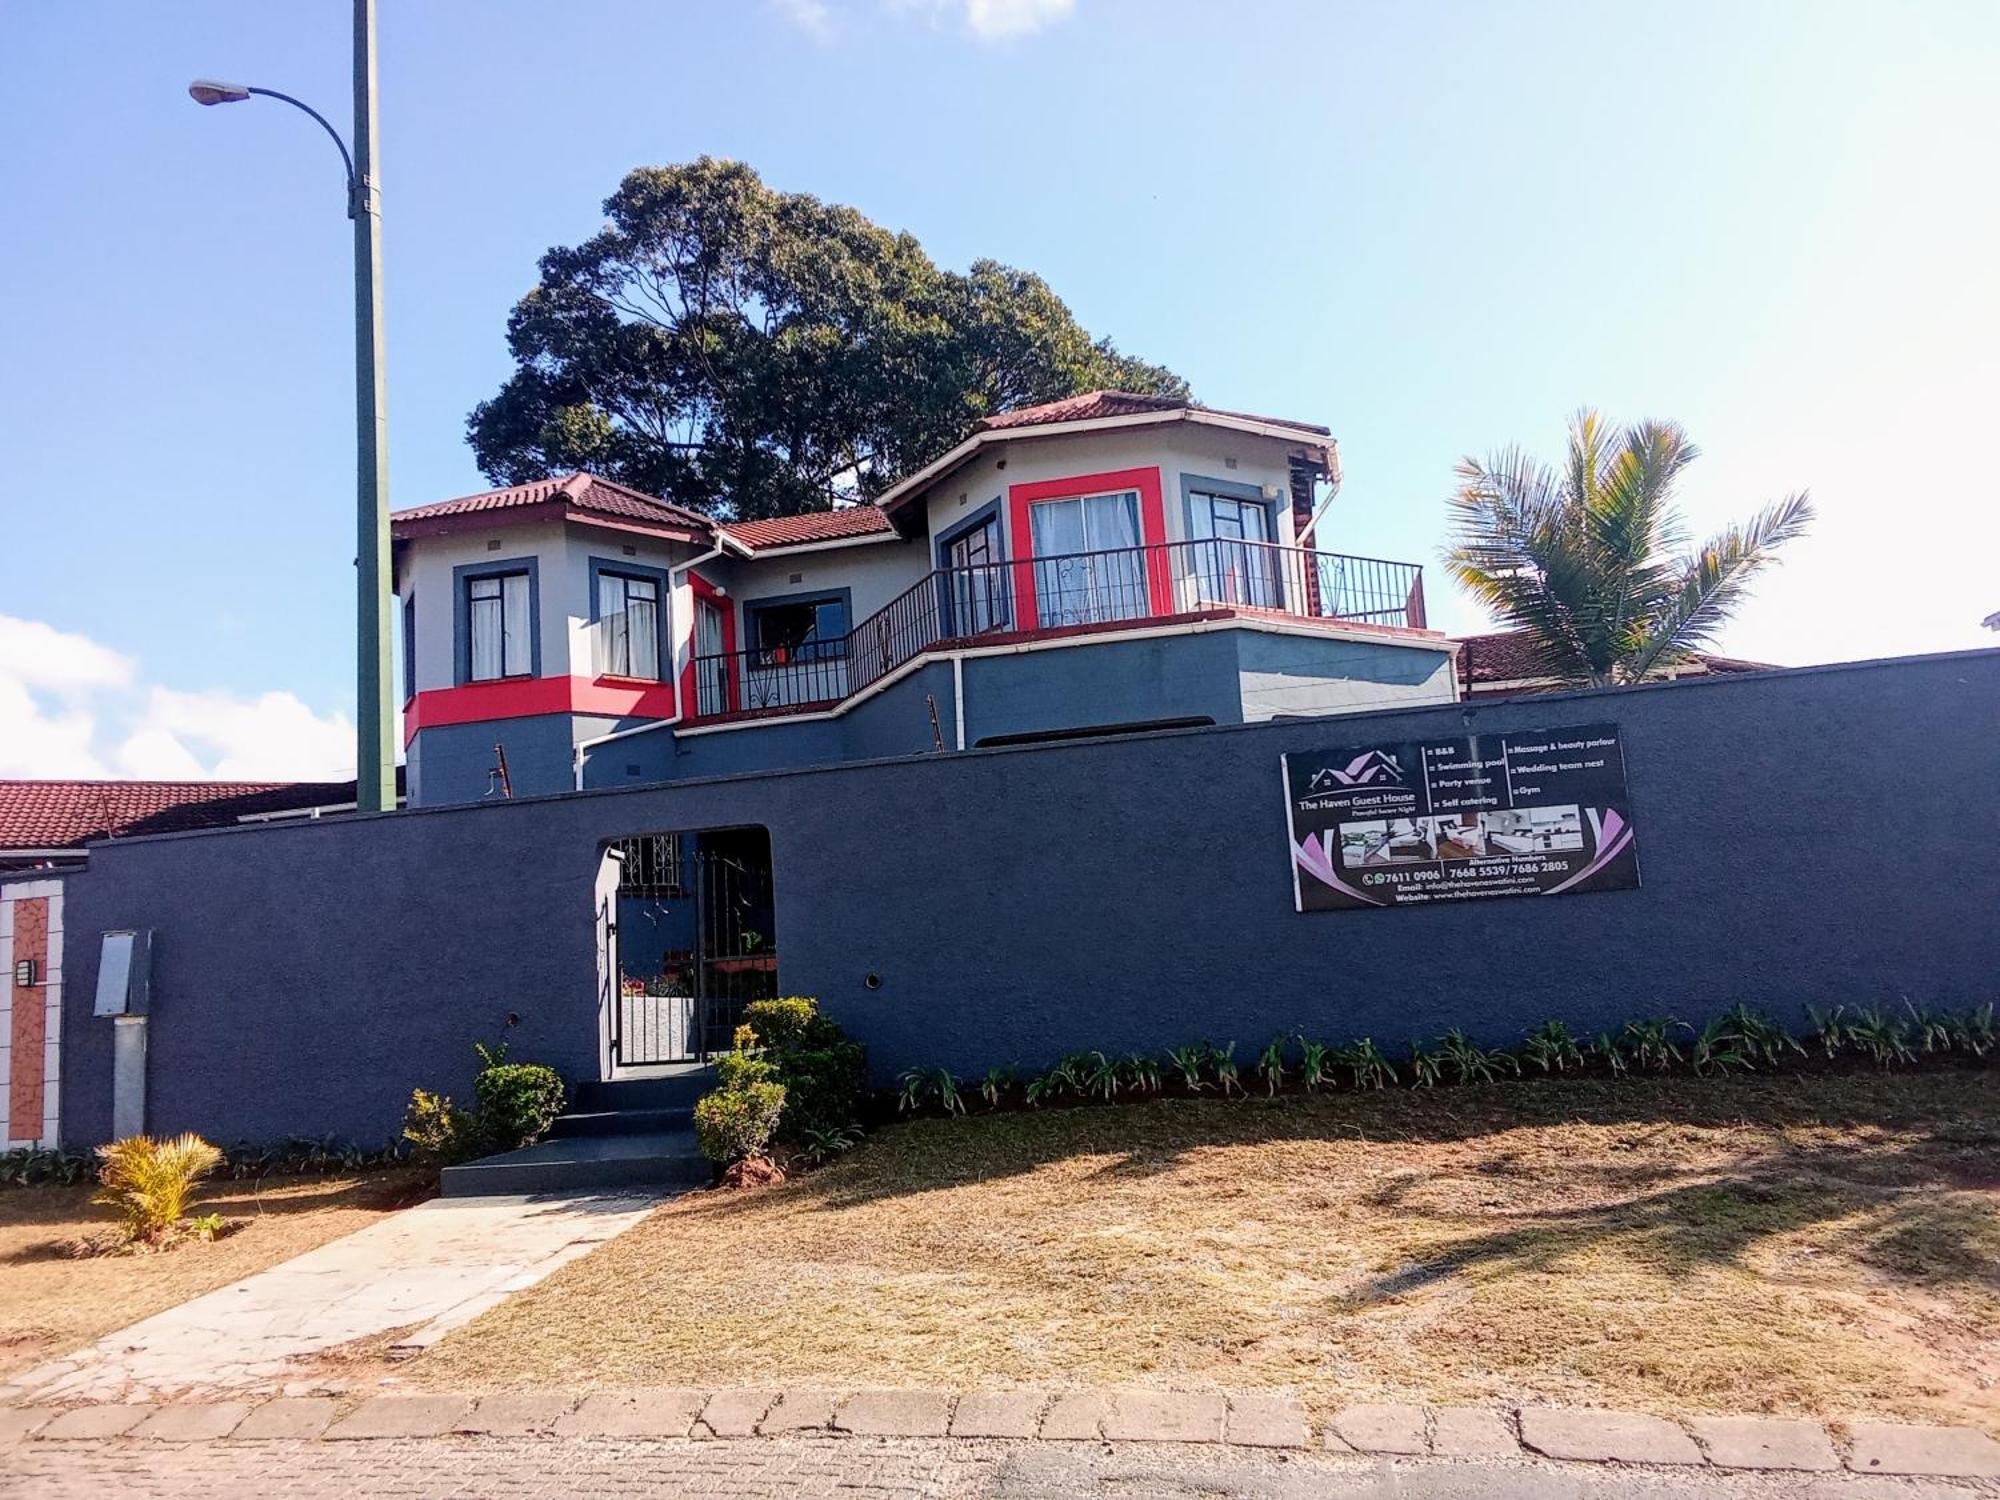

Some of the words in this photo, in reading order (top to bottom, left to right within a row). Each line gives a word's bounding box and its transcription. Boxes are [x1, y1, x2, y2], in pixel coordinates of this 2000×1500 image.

[1558, 741, 1584, 749] beauty
[1435, 747, 1454, 755] B&B
[1438, 760, 1483, 771] Swimming
[1485, 757, 1505, 768] pool
[1516, 764, 1557, 773] Wedding
[1439, 780, 1462, 788] Party
[1520, 786, 1540, 795] Gym
[1299, 801, 1317, 810] The
[1320, 799, 1350, 808] Haven
[1352, 796, 1381, 805] Guest
[1383, 794, 1415, 803] House
[1442, 798, 1458, 807] Self
[1461, 796, 1497, 805] catering
[1449, 867, 1476, 878] 7668
[1541, 861, 1569, 872] 2805
[1385, 872, 1410, 883] 7611
[1413, 870, 1440, 880] 0906
[1397, 883, 1422, 892] Email:
